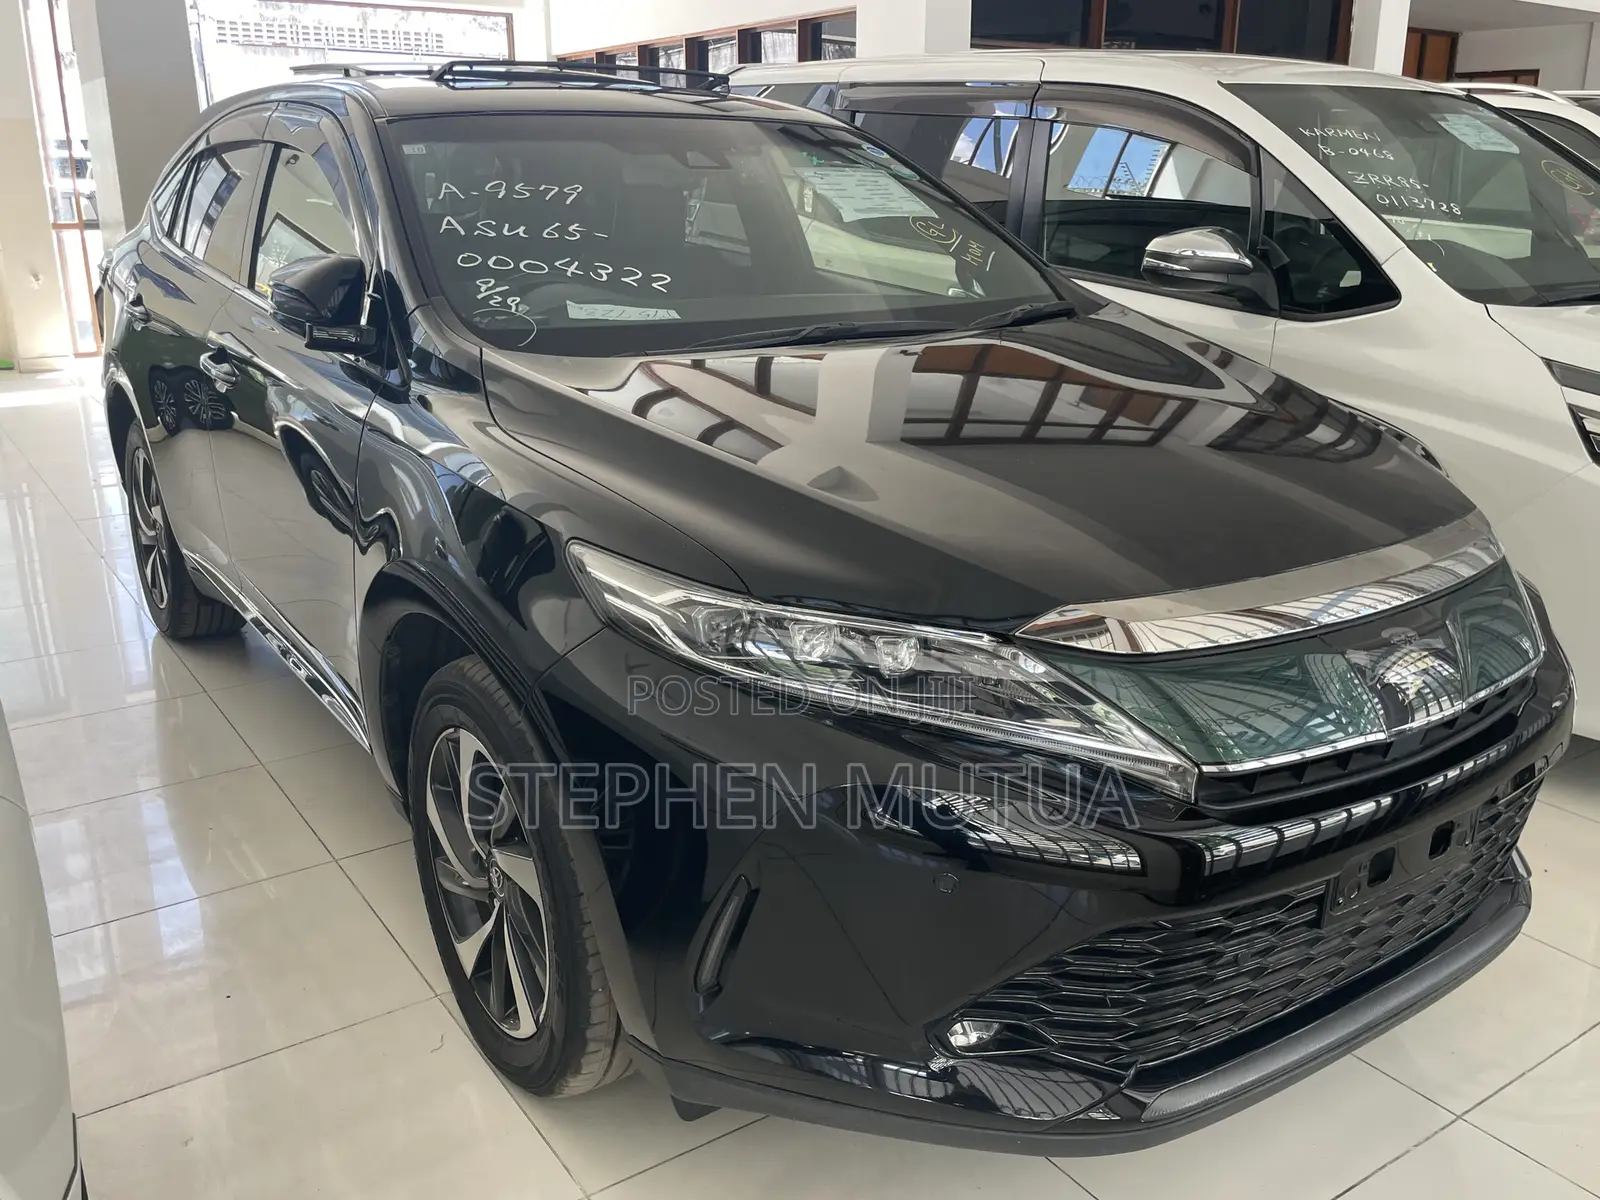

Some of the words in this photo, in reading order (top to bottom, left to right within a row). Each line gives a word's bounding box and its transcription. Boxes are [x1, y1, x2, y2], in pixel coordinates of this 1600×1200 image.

[1298, 127, 1381, 142] KARMEN
[438, 180, 583, 205] A-9579
[1376, 193, 1462, 215] 0113728
[456, 252, 673, 293] 0004322
